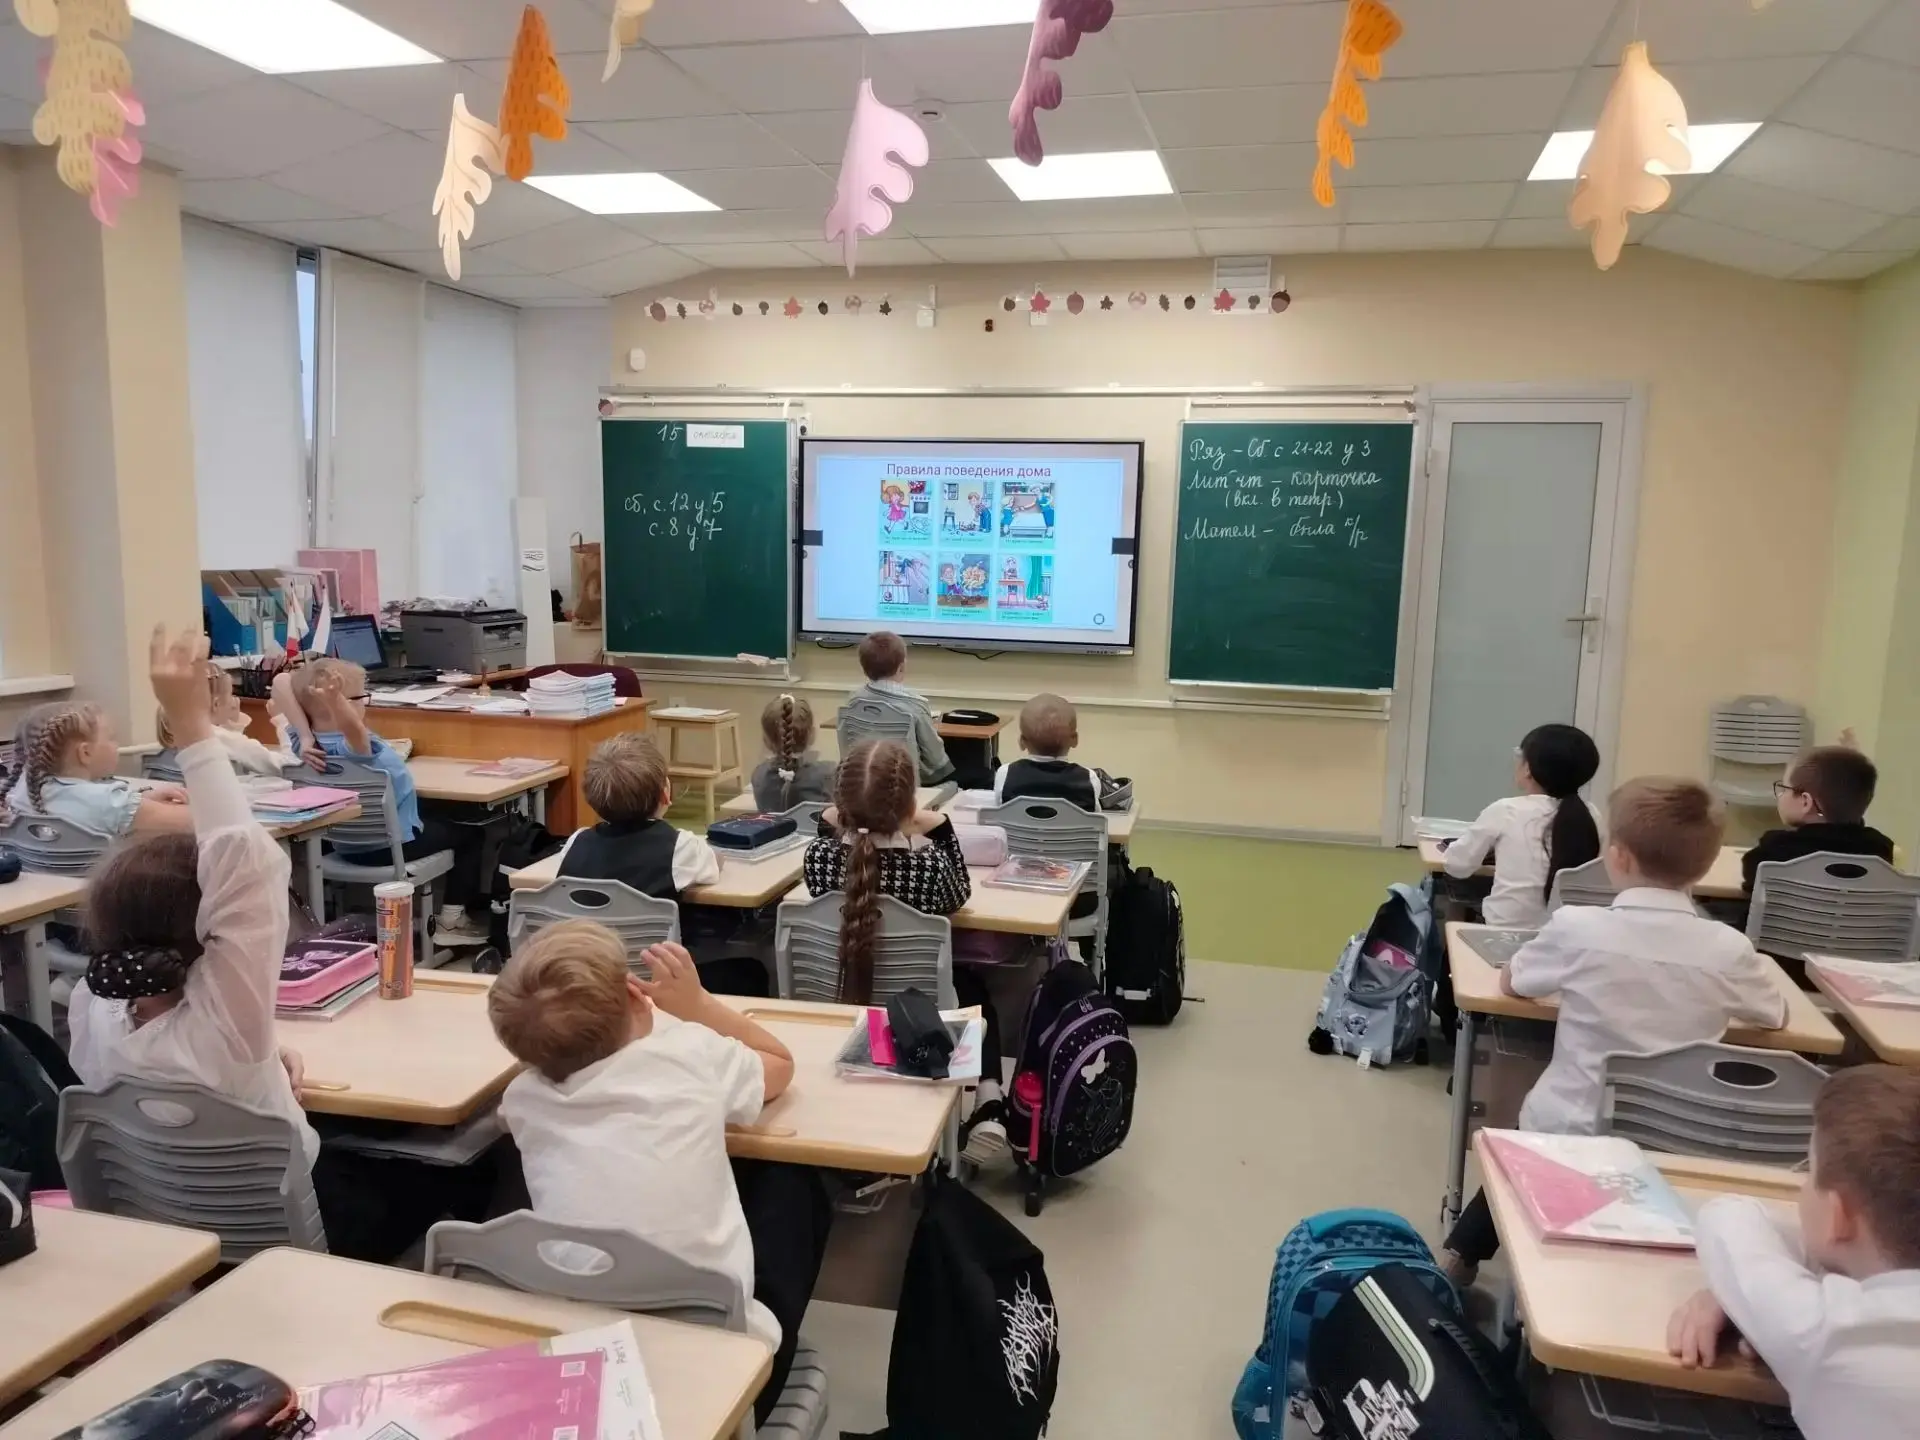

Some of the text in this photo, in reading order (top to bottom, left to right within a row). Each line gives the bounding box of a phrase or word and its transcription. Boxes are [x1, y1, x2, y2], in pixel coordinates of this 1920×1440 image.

[657, 424, 684, 442] 15
[1291, 441, 1333, 456] 21-22
[1341, 443, 1354, 466] у
[1361, 440, 1371, 457] 3
[886, 463, 1052, 478] Правила поведения дома
[1290, 470, 1382, 499] карточка
[1271, 487, 1281, 507] в
[1184, 517, 1257, 540] Матем
[1289, 515, 1336, 537] была
